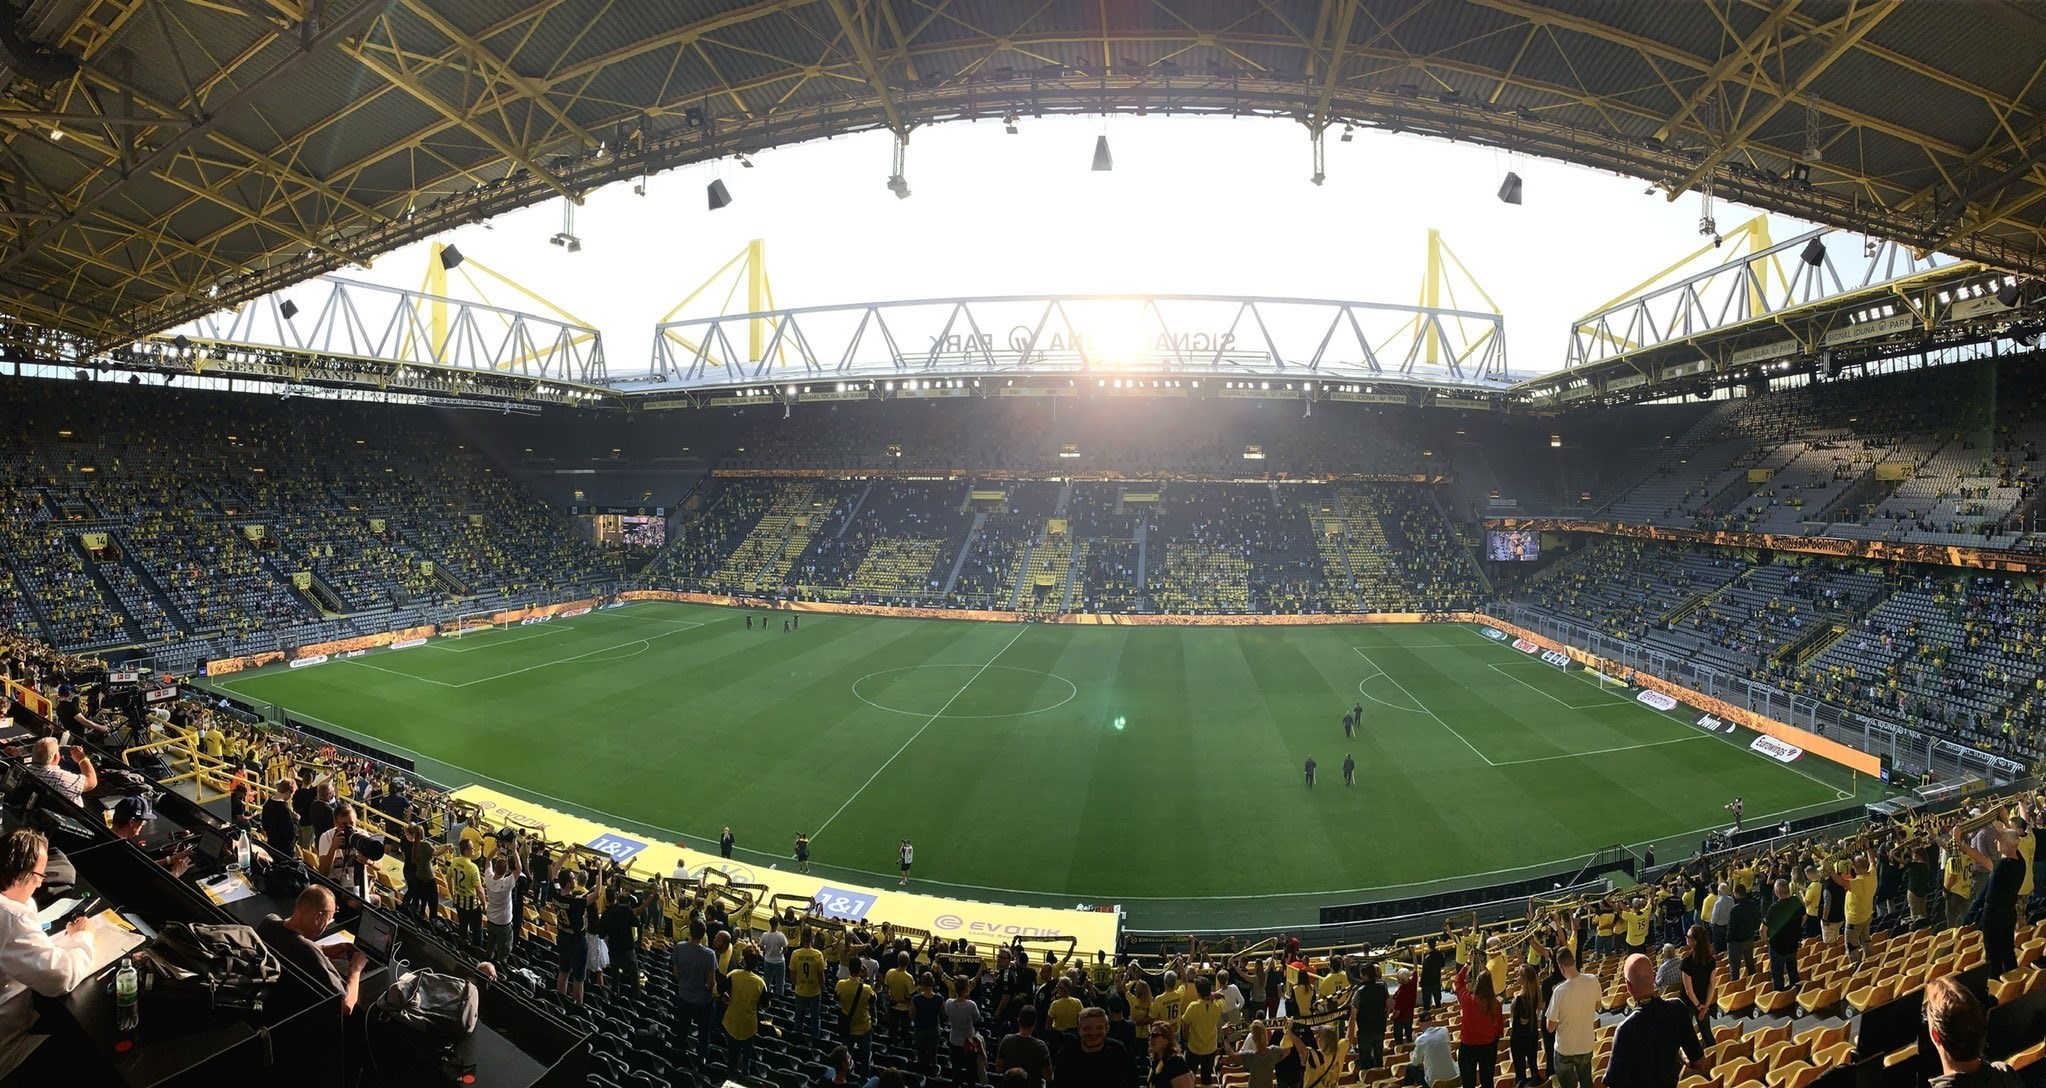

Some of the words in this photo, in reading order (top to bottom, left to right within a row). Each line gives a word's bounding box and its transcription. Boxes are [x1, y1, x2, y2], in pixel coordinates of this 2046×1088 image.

[1828, 330, 1852, 342] SIGNAL
[1853, 326, 1876, 337] IDUNA
[1889, 317, 1911, 329] PARK
[1901, 467, 1912, 477] 72
[254, 528, 264, 537] 13
[96, 536, 106, 546] 14
[347, 648, 366, 658] bwin
[1697, 713, 1722, 731] bwin
[1755, 736, 1788, 757] Eurowings
[595, 836, 636, 859] 1&1
[453, 867, 466, 890] 12
[814, 893, 866, 916] 1&1
[969, 921, 1061, 937] EVONIK
[1637, 920, 1646, 930] 15
[802, 962, 810, 979] 9
[1166, 1004, 1179, 1020] 16
